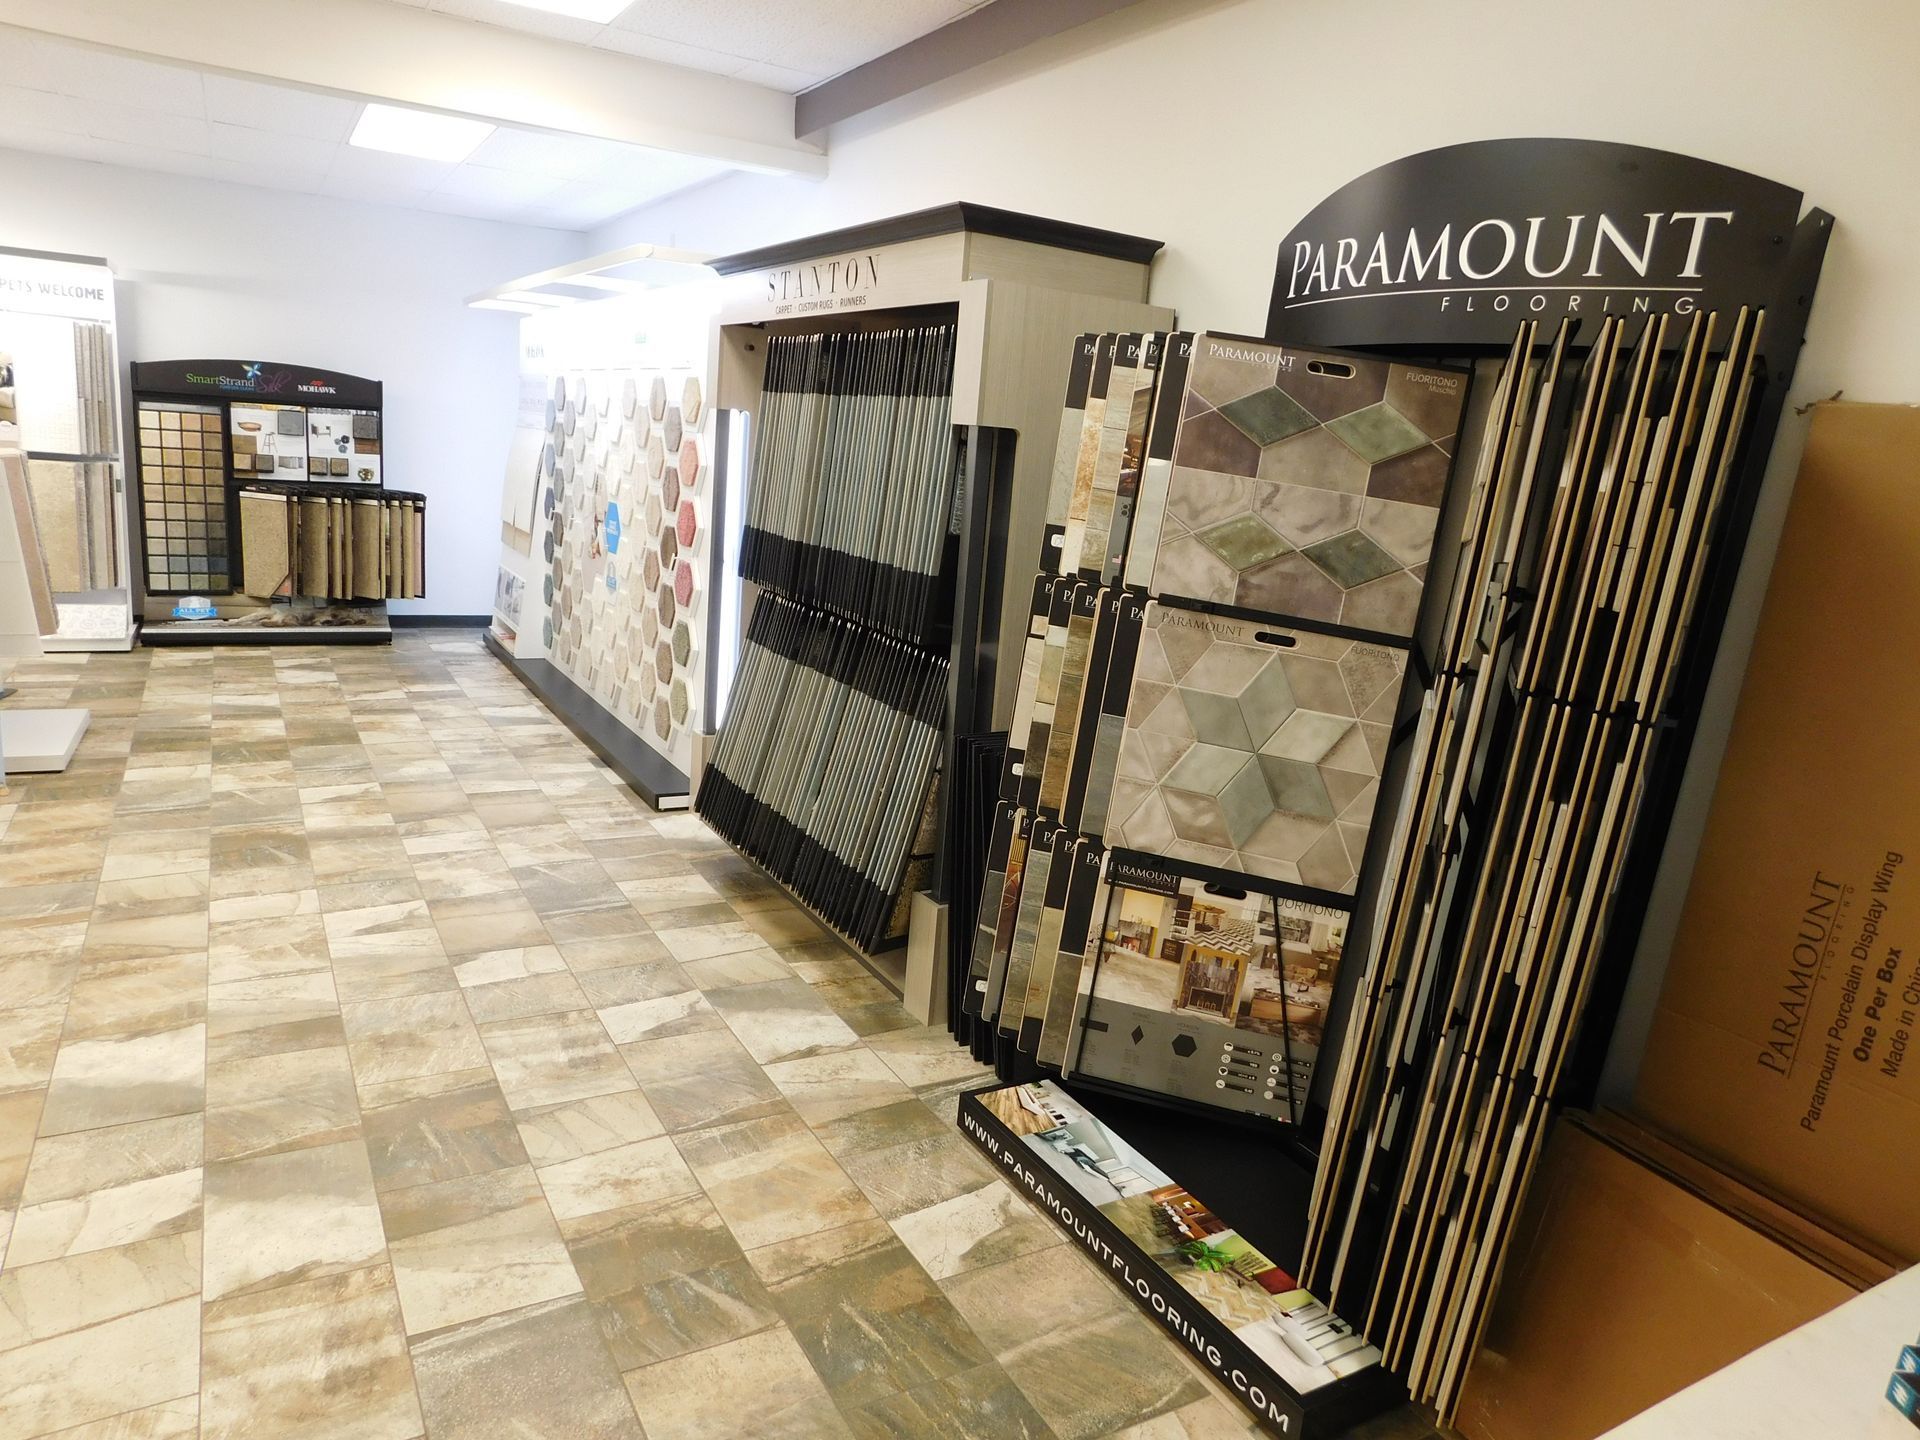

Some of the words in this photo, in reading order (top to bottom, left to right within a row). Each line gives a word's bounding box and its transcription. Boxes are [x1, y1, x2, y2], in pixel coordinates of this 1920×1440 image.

[1286, 210, 1734, 299] PARAMOUNT
[38, 283, 105, 301] WELCOME
[767, 254, 881, 303] STANTON
[775, 304, 793, 315] CARPET
[798, 301, 819, 313] CUSTOM
[819, 299, 833, 311] RUGS
[840, 295, 867, 307] RUNNERS
[1440, 295, 1696, 315] FLOORING
[1208, 343, 1297, 367] PARAMOUNT
[186, 373, 255, 387] SmartStrand
[297, 384, 337, 395] MOHAWK
[1406, 372, 1459, 388] FUORITONO
[1161, 611, 1245, 638] PARAMOUNT
[1757, 870, 1842, 1076] PARAMOUNT
[1876, 946, 1903, 984] Box
[1800, 1041, 1841, 1133] Paramount
[1827, 963, 1864, 1042] Porcelain
[1850, 898, 1888, 961] Display
[1870, 850, 1903, 896] Wing
[1864, 984, 1889, 1022] Per
[1852, 1023, 1878, 1063] One
[1880, 1027, 1910, 1079] Made
[1899, 1008, 1916, 1027] in
[963, 1111, 1289, 1434] WWW.PARAMOUNTFLOORING.COM
